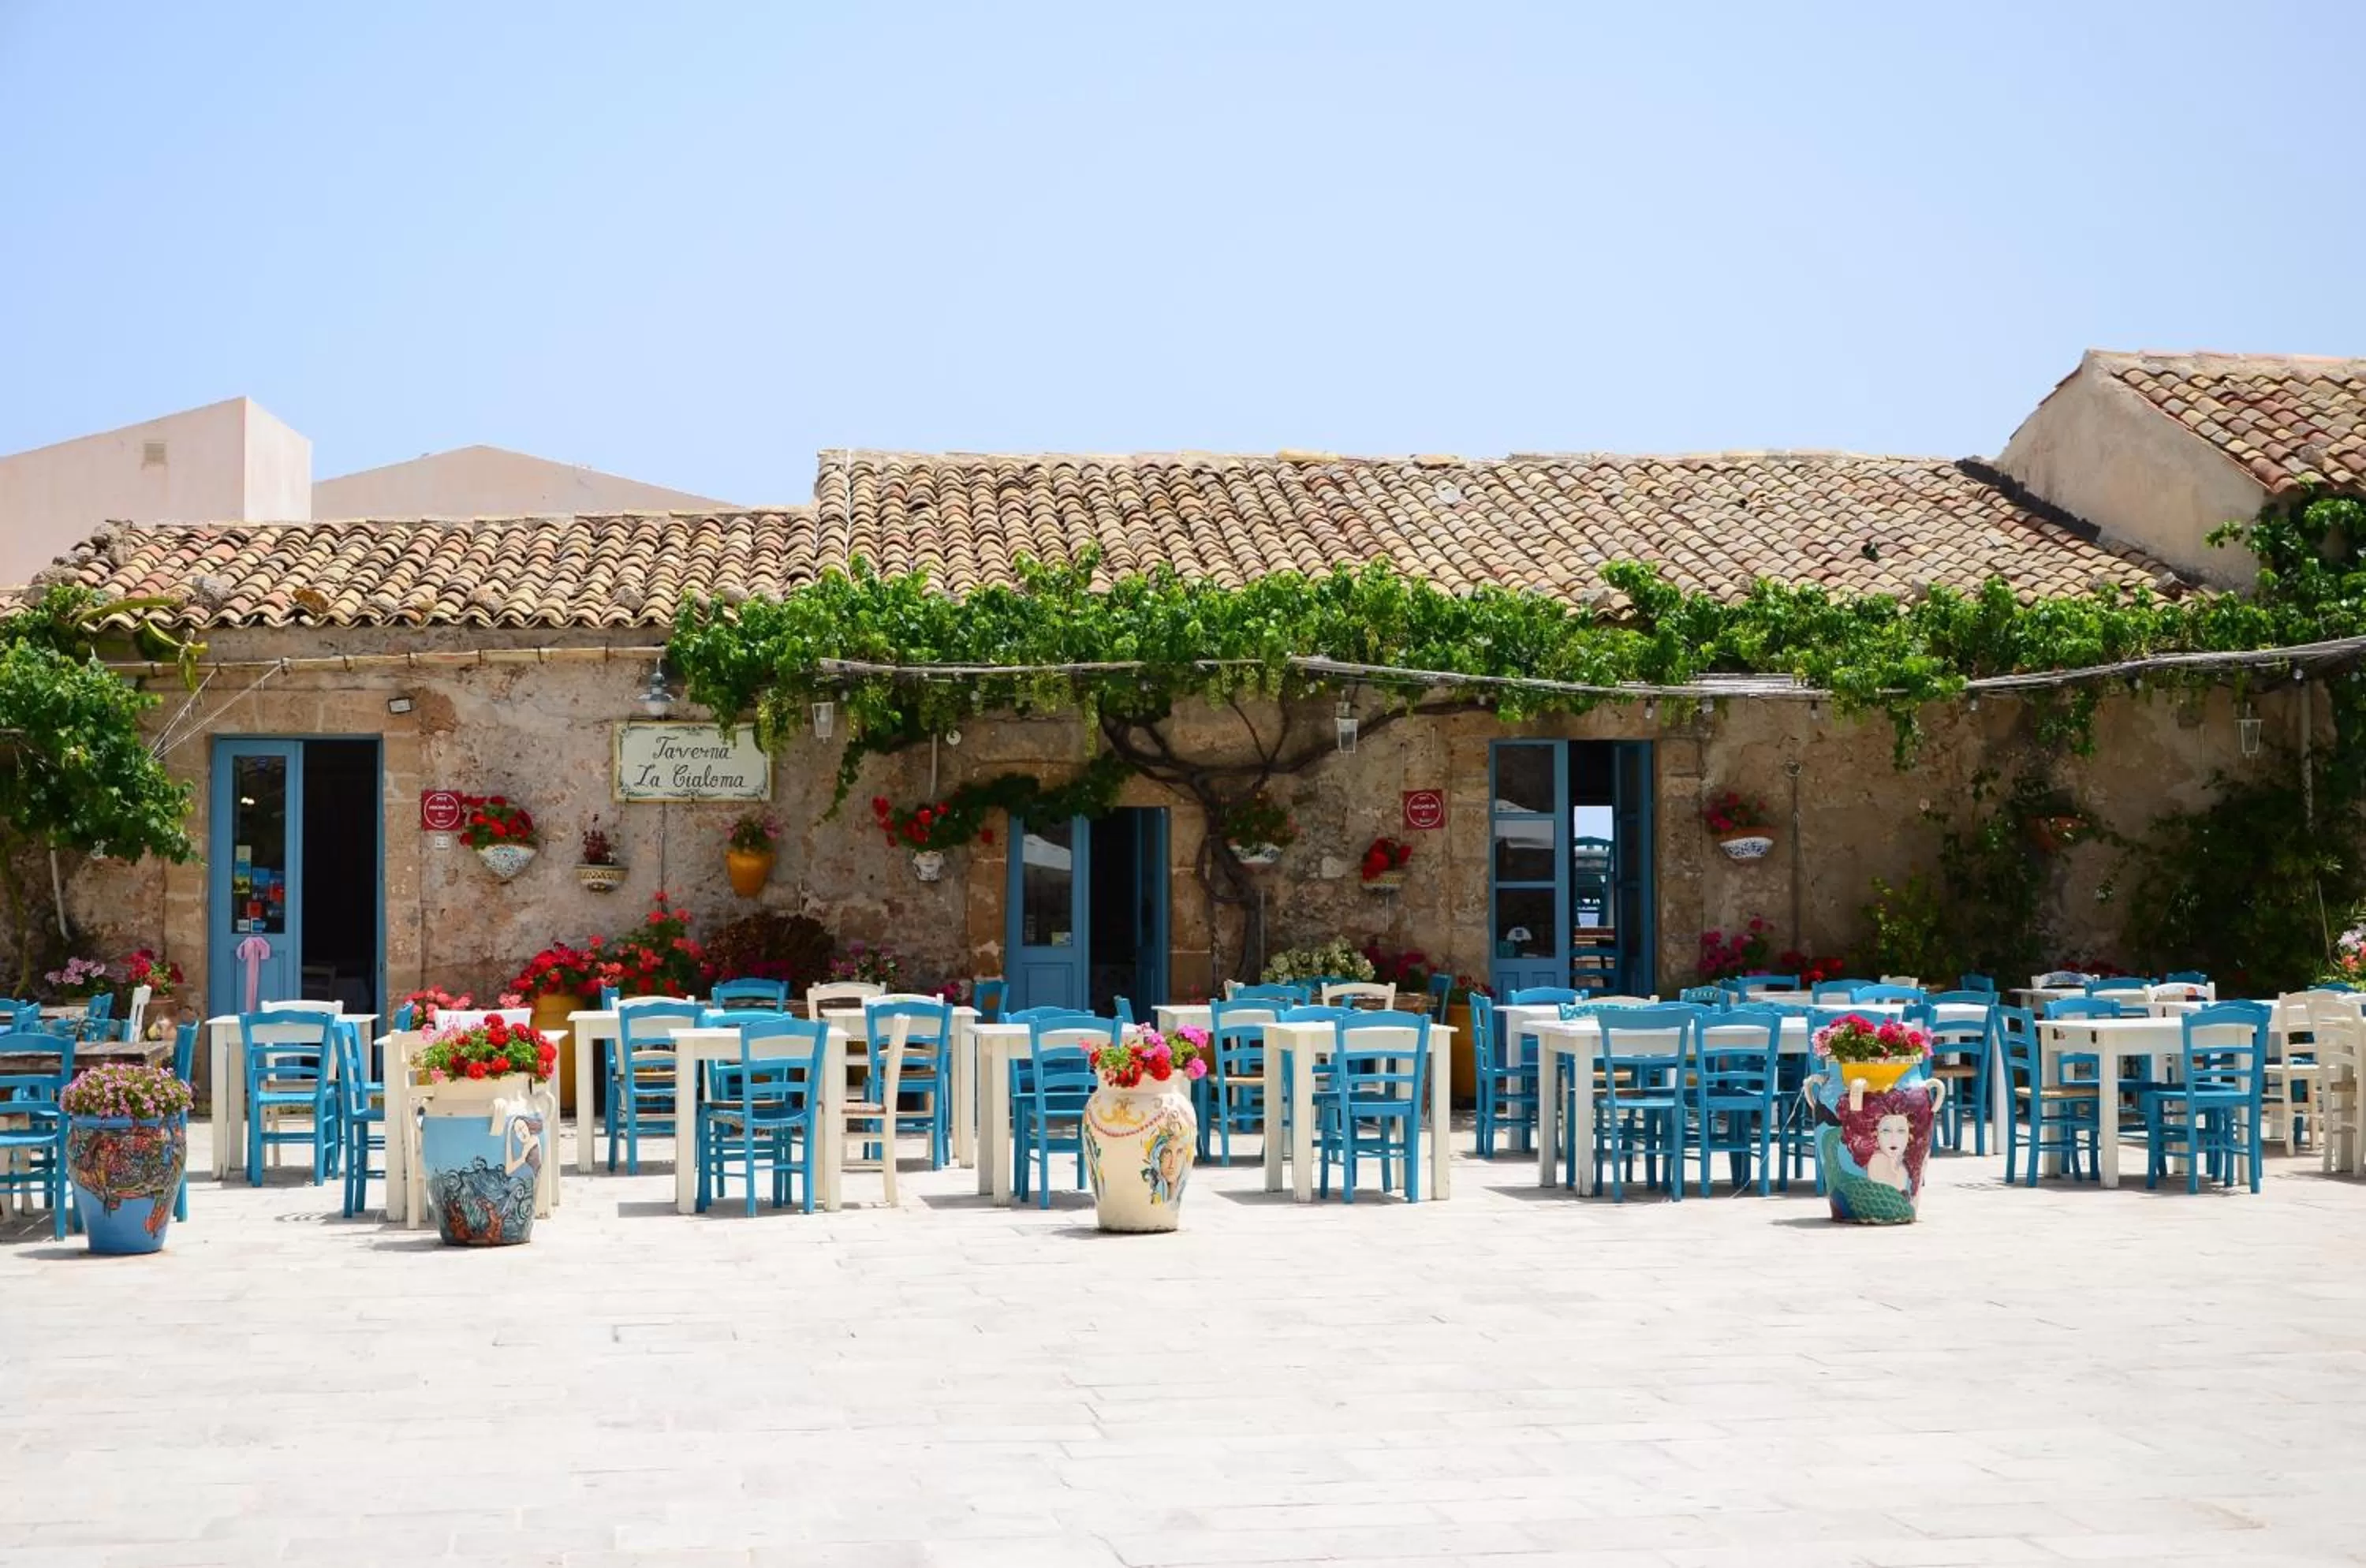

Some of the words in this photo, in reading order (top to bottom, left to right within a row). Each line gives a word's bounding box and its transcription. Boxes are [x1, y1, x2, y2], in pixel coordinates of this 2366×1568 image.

[653, 736, 732, 760] Taverna
[634, 763, 661, 788] La
[673, 763, 745, 788] Cialoma
